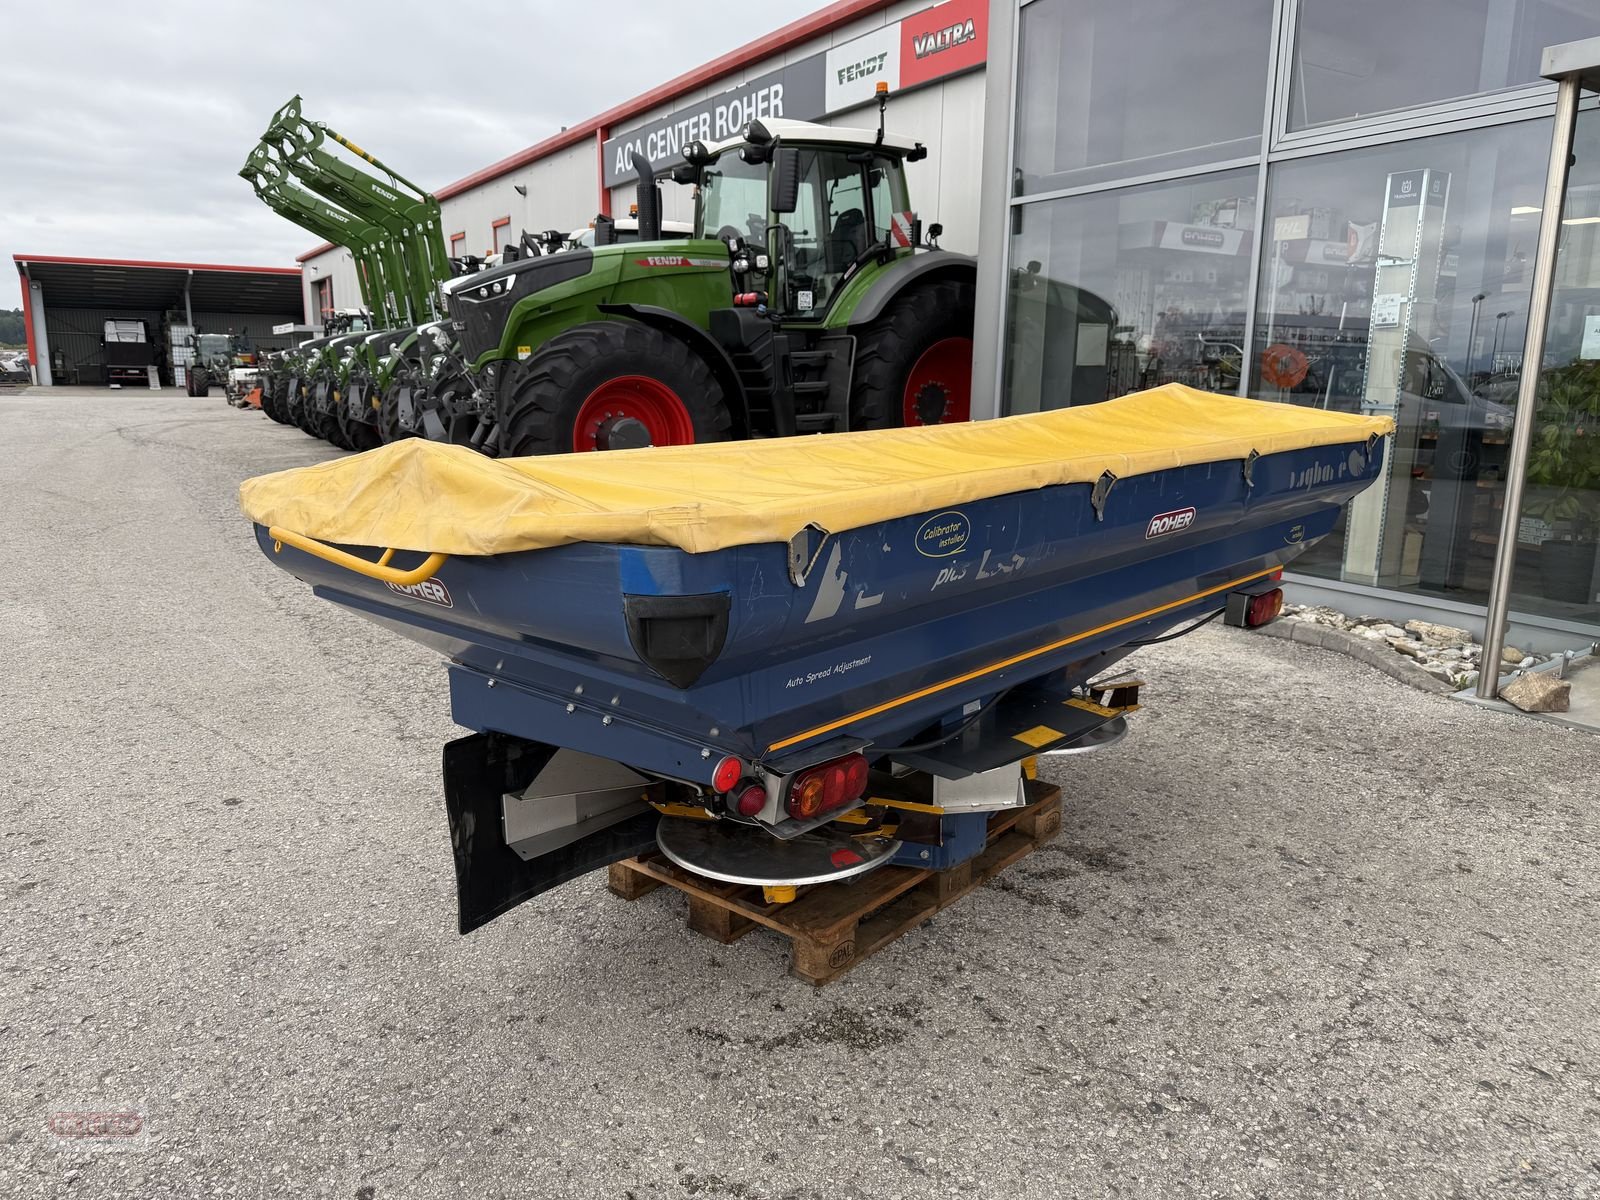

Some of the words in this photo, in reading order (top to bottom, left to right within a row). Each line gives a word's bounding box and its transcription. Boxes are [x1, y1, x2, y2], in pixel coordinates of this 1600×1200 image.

[913, 18, 976, 60] VALTRA
[837, 52, 887, 85] FENDT
[647, 112, 710, 162] CENTER
[716, 83, 784, 139] ROHER
[371, 184, 399, 202] FENDT
[326, 208, 350, 223] FENDT
[647, 256, 684, 266] FENDT
[923, 522, 962, 540] Calibrator
[1149, 512, 1193, 536] ROHER
[939, 531, 965, 548] installed
[785, 678, 804, 689] Auto
[806, 666, 832, 684] Spread
[833, 654, 872, 674] Adjustment
